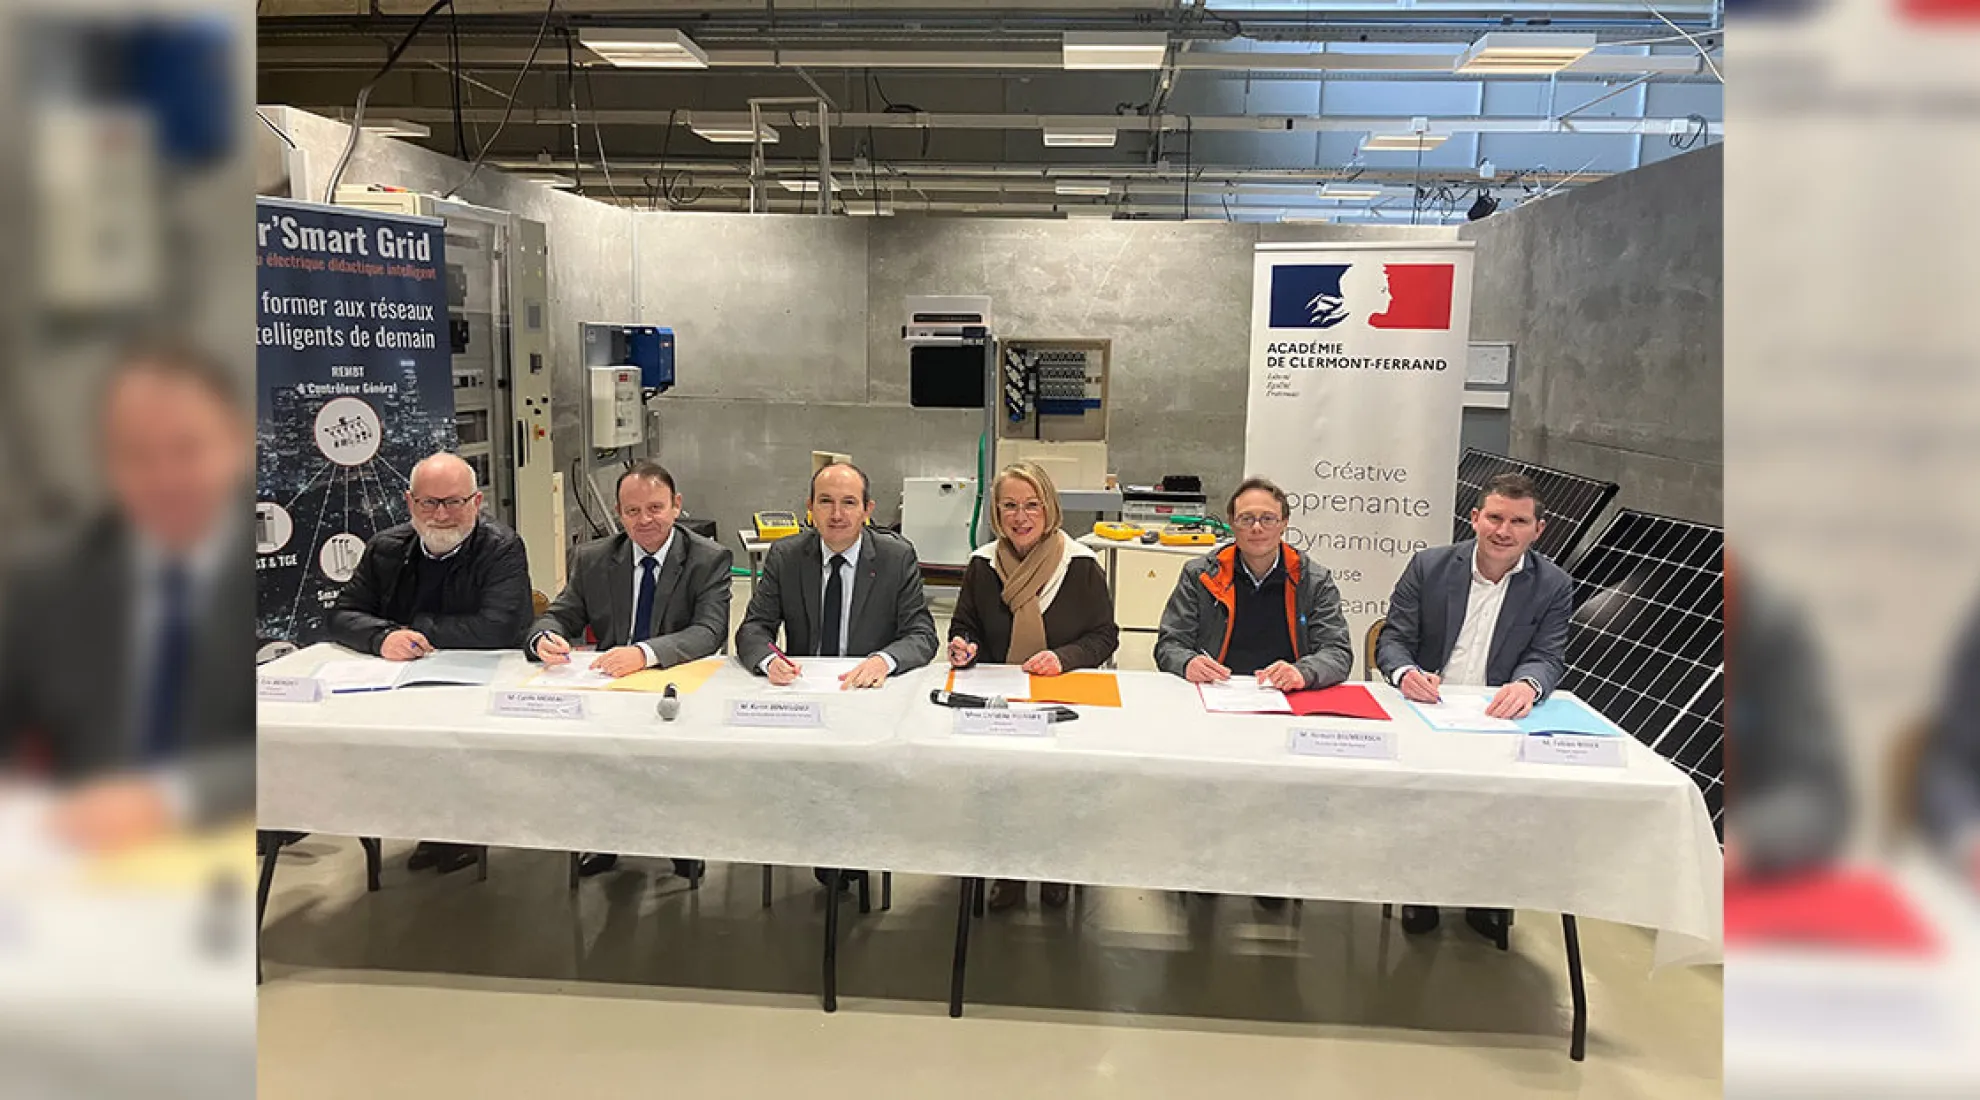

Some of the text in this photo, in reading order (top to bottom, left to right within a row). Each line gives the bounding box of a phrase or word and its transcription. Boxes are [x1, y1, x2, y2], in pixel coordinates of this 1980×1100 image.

[377, 227, 431, 261] Grid
[328, 258, 384, 277] didactique
[261, 290, 434, 321] former aux réseaux
[350, 325, 370, 349] de
[375, 326, 436, 350] demain
[1267, 340, 1343, 355] ACADÉMIE
[1267, 357, 1447, 371] DE CLERMONT-FERRAND
[1315, 460, 1407, 482] Créative
[1285, 526, 1428, 557] Dynamique
